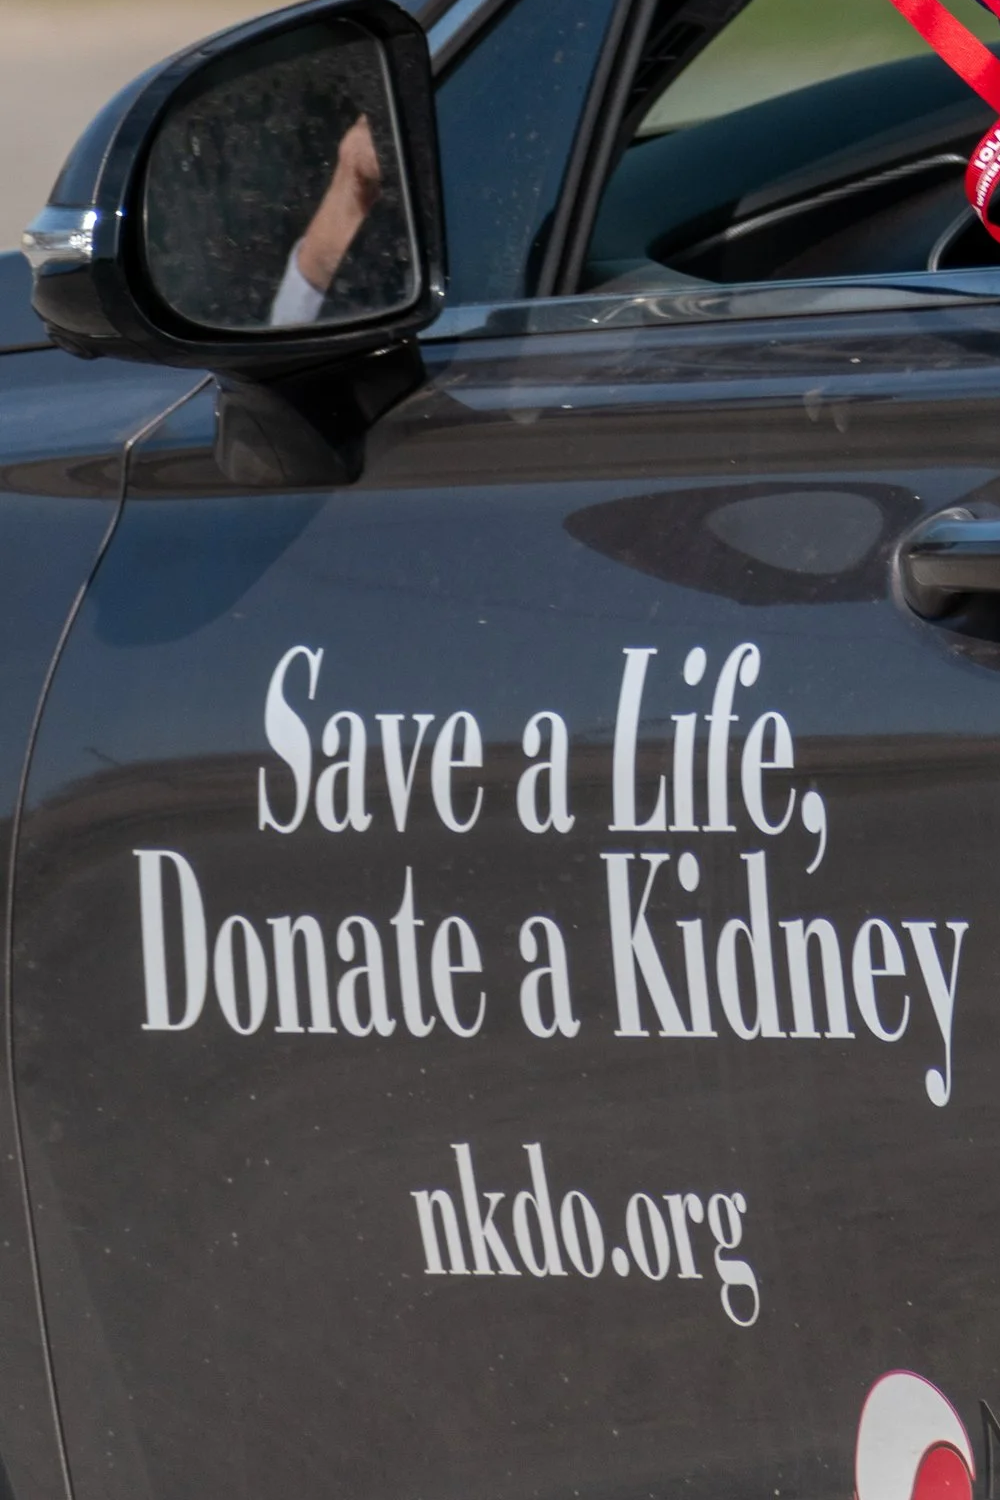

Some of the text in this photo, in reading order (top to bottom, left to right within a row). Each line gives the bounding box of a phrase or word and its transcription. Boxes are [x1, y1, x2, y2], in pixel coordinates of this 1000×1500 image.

[258, 642, 827, 874] Save a Life,
[132, 849, 970, 1107] Donate a Kidney
[410, 1142, 761, 1328] nkdo.org
